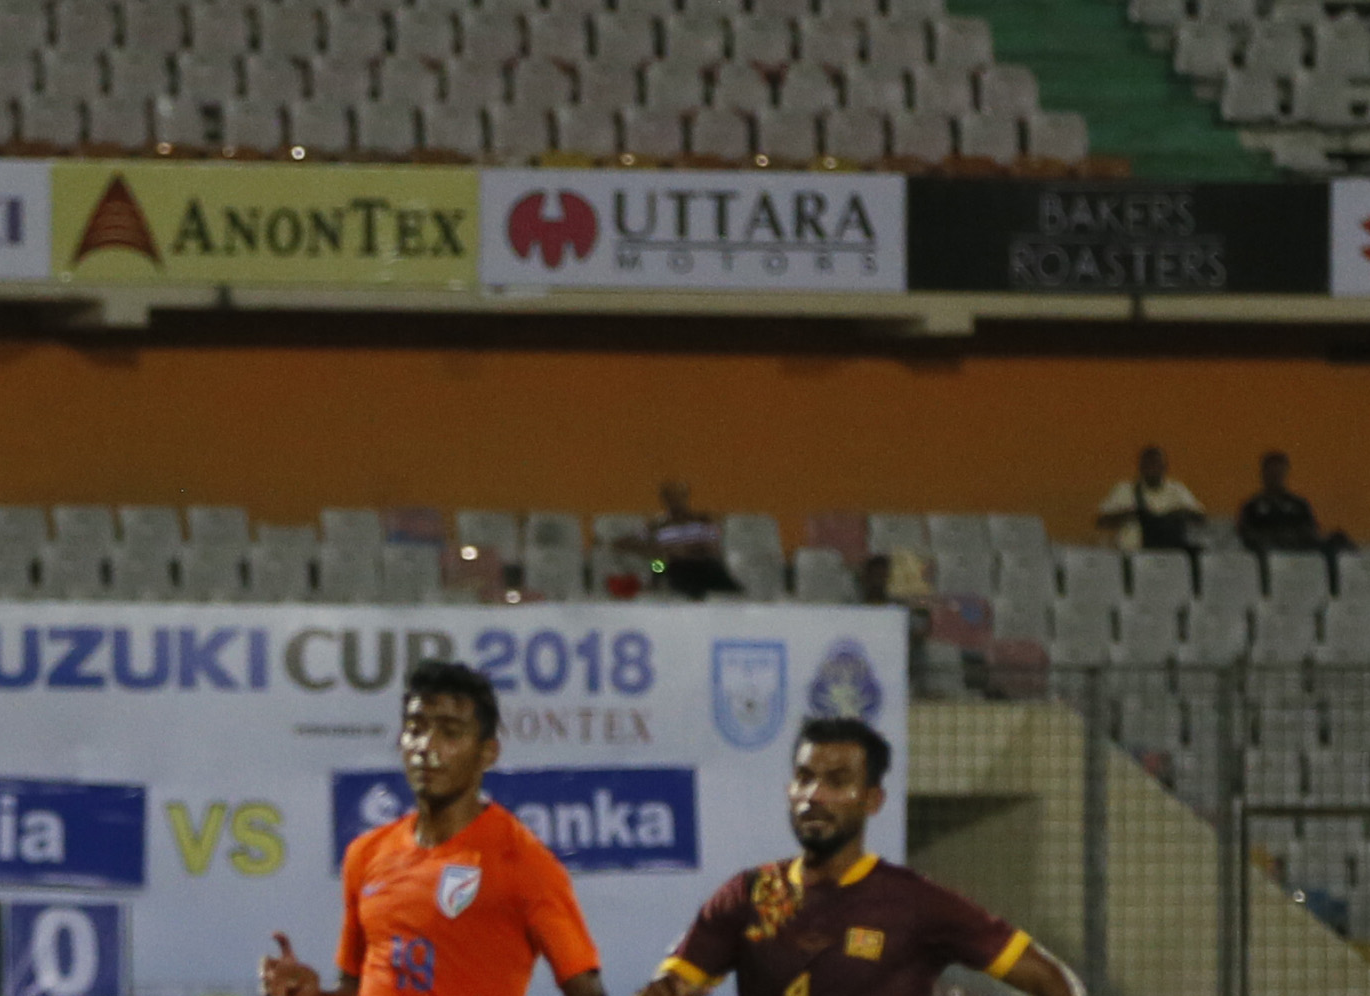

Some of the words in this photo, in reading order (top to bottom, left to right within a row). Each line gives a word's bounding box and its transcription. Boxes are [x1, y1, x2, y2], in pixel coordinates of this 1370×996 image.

[613, 188, 877, 240] UTTARA
[1038, 193, 1194, 237] BAKERS
[1008, 243, 1227, 288] ROASTERS
[474, 628, 655, 695] 2018
[497, 707, 654, 745] ONTEX
[479, 787, 677, 849] anka
[391, 934, 434, 992] 19
